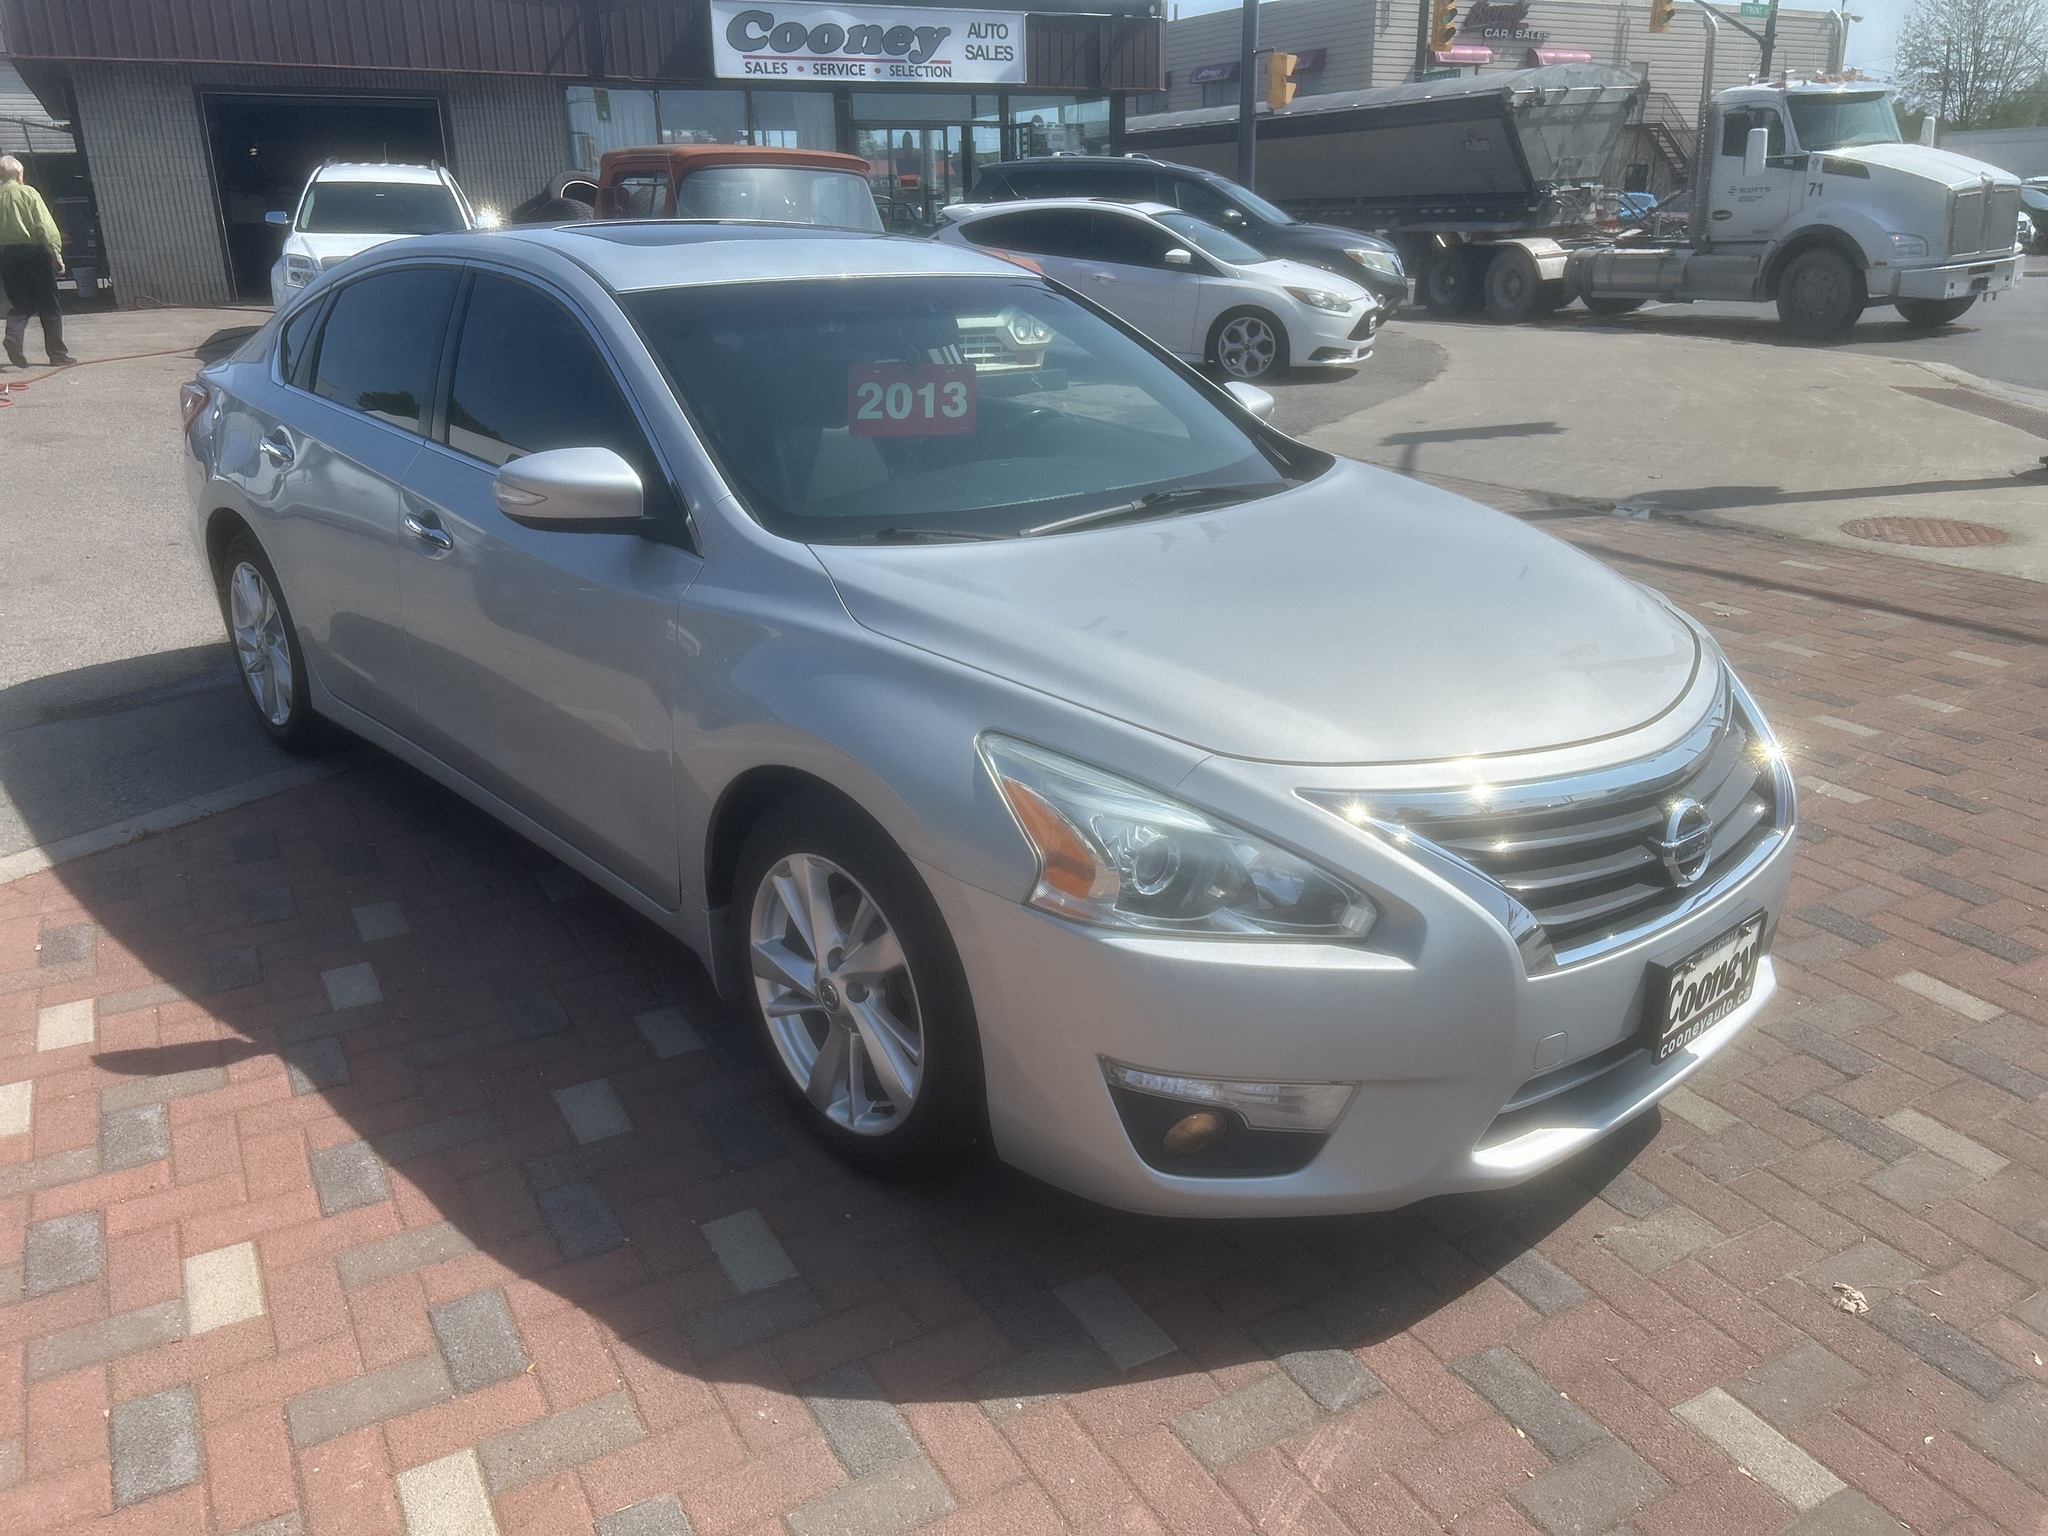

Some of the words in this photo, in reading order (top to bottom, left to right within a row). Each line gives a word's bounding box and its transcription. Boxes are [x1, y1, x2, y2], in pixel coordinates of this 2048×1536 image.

[726, 10, 951, 64] Cooney
[967, 22, 1008, 40] AUTO
[1484, 28, 1508, 38] CAR
[1515, 29, 1551, 40] SALES
[965, 44, 1014, 62] SALES
[744, 61, 788, 75] SALES
[812, 62, 866, 77] SERVICE
[889, 64, 952, 78] SELECTION
[1808, 183, 1824, 197] 71
[857, 381, 968, 420] 2013
[1666, 941, 1757, 1031] Cooney
[1660, 985, 1752, 1059] cooneyauto.ca
